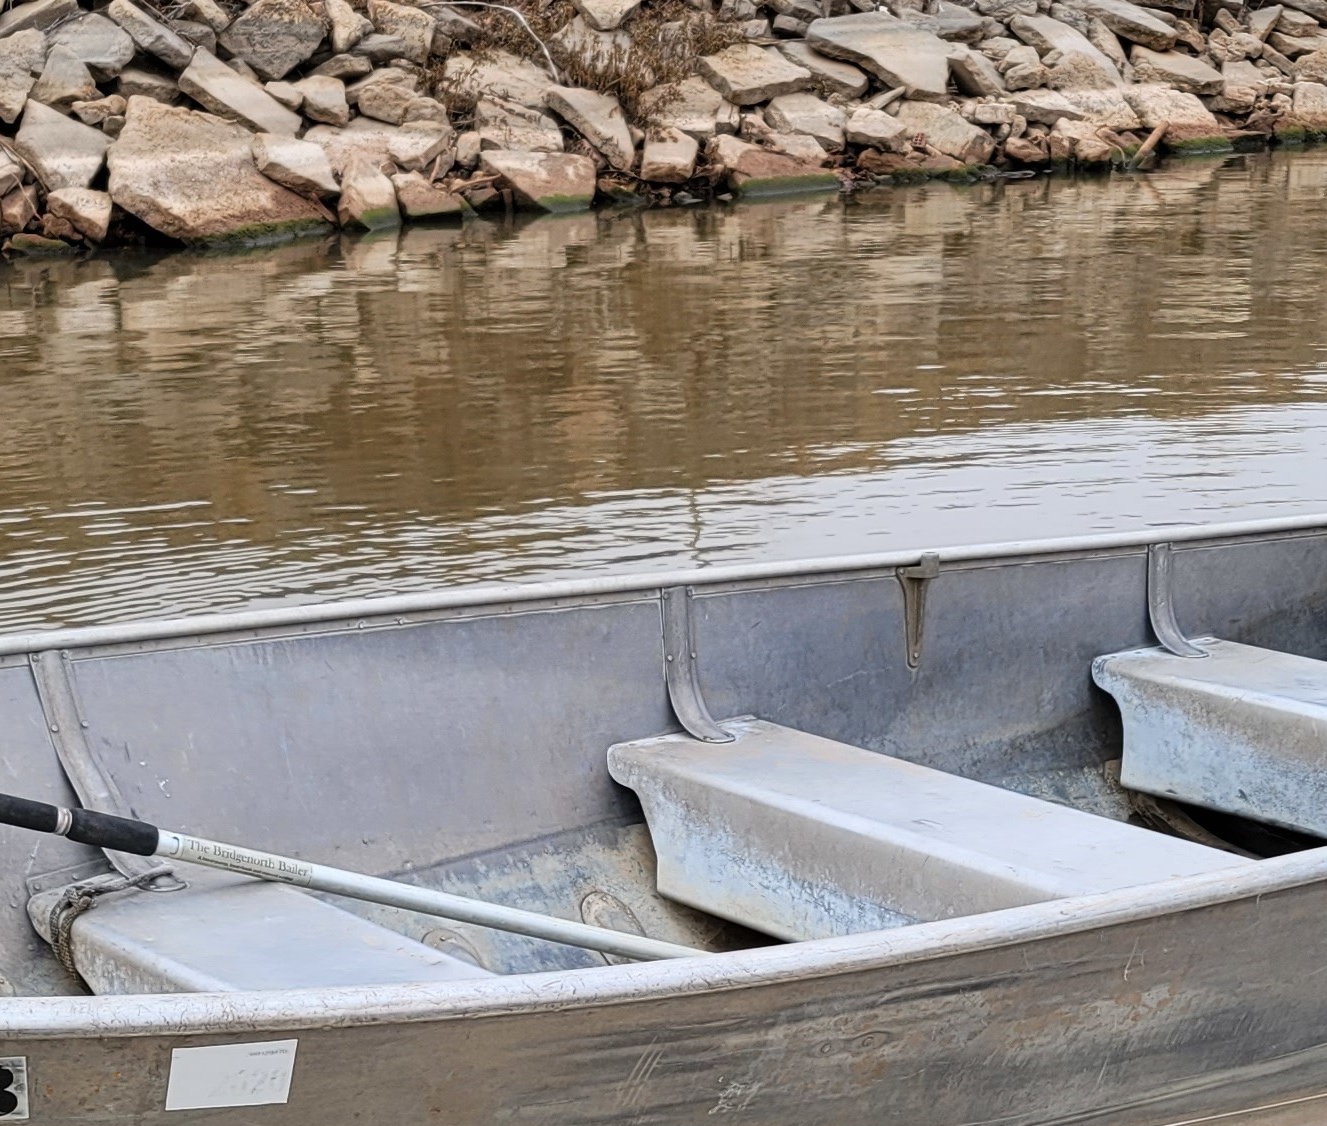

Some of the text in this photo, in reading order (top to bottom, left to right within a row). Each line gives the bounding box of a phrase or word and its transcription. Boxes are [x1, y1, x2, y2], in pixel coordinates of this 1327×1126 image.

[187, 839, 210, 854] The
[214, 846, 274, 870] Bridgenorth
[278, 860, 309, 877] Bailer
